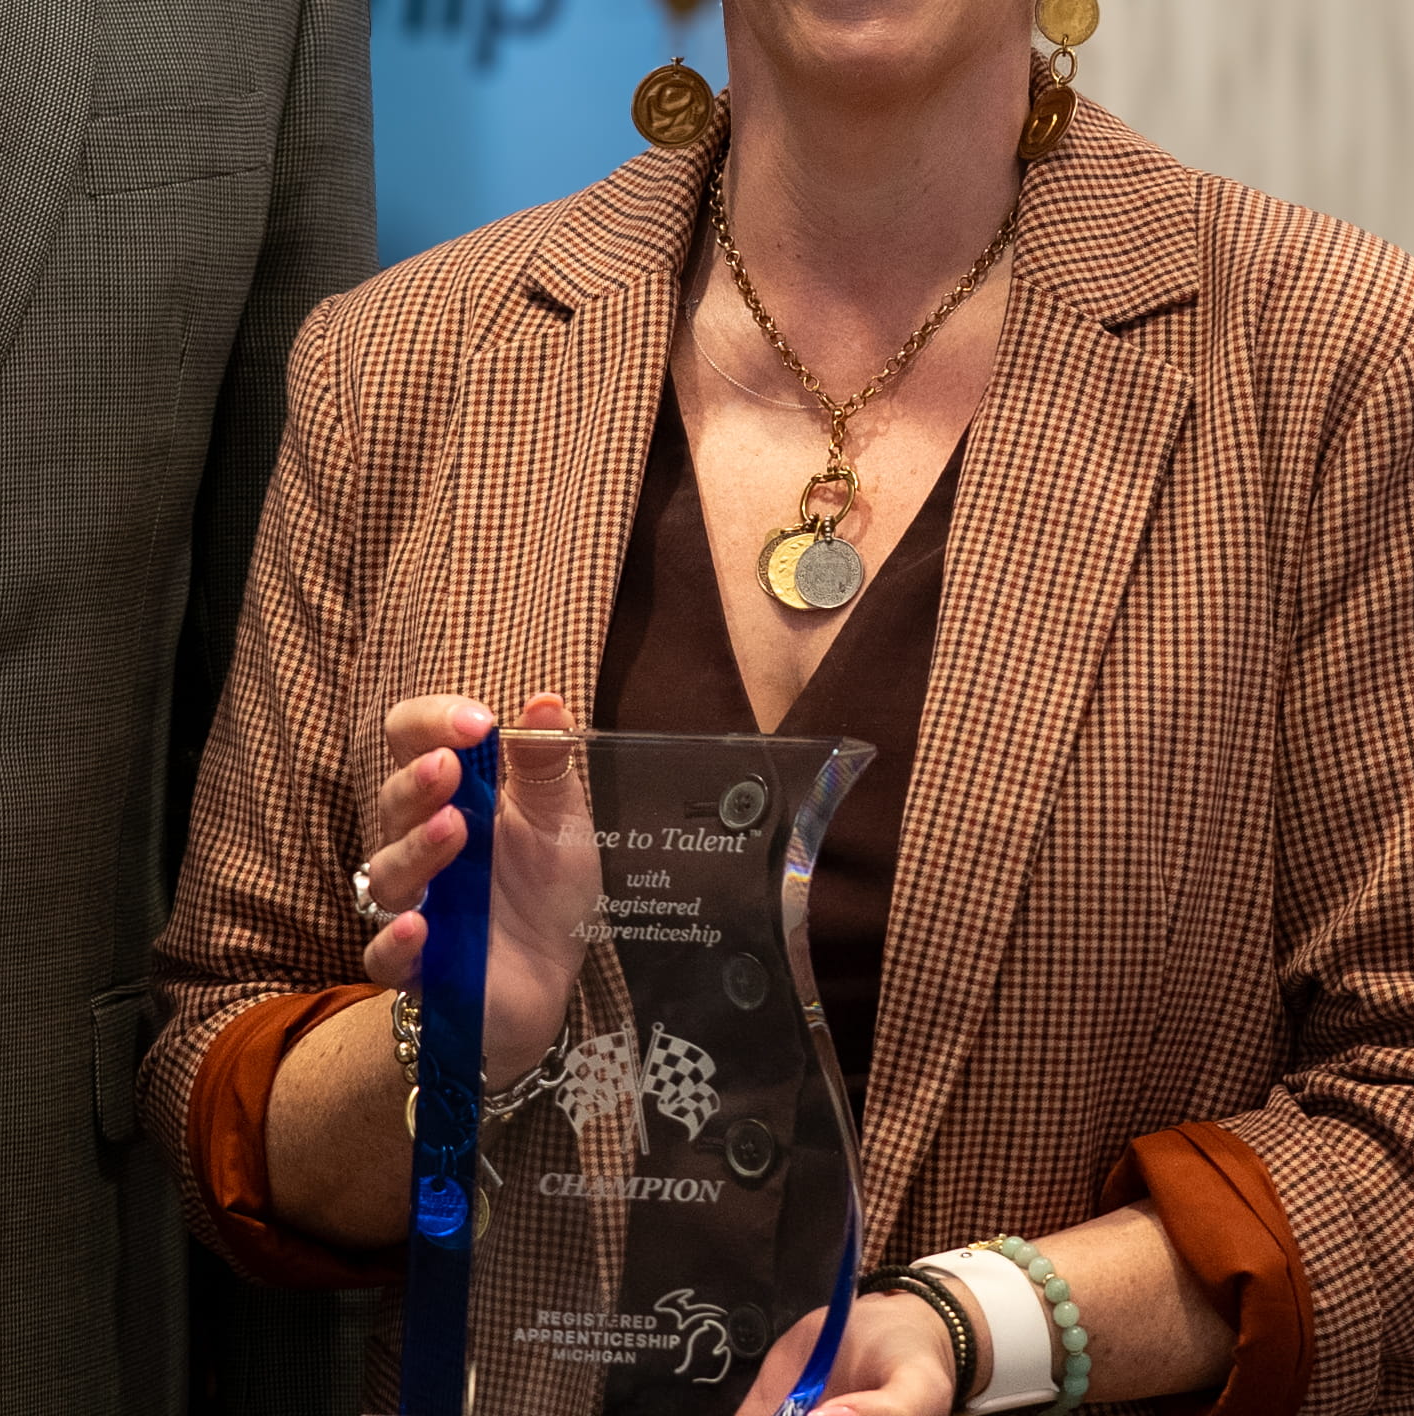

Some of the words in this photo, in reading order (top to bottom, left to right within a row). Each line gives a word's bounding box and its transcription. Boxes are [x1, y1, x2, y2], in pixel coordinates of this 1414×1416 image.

[554, 824, 620, 849] Rce
[627, 828, 653, 850] to
[626, 870, 671, 889] with
[593, 894, 702, 917] Registered
[569, 921, 722, 947] Apprenticeship
[538, 1172, 726, 1203] CHAMPION
[537, 1309, 658, 1330] REGISTERED
[512, 1327, 682, 1350] APPRENTICESHIP
[552, 1348, 637, 1364] MICHIGAN
